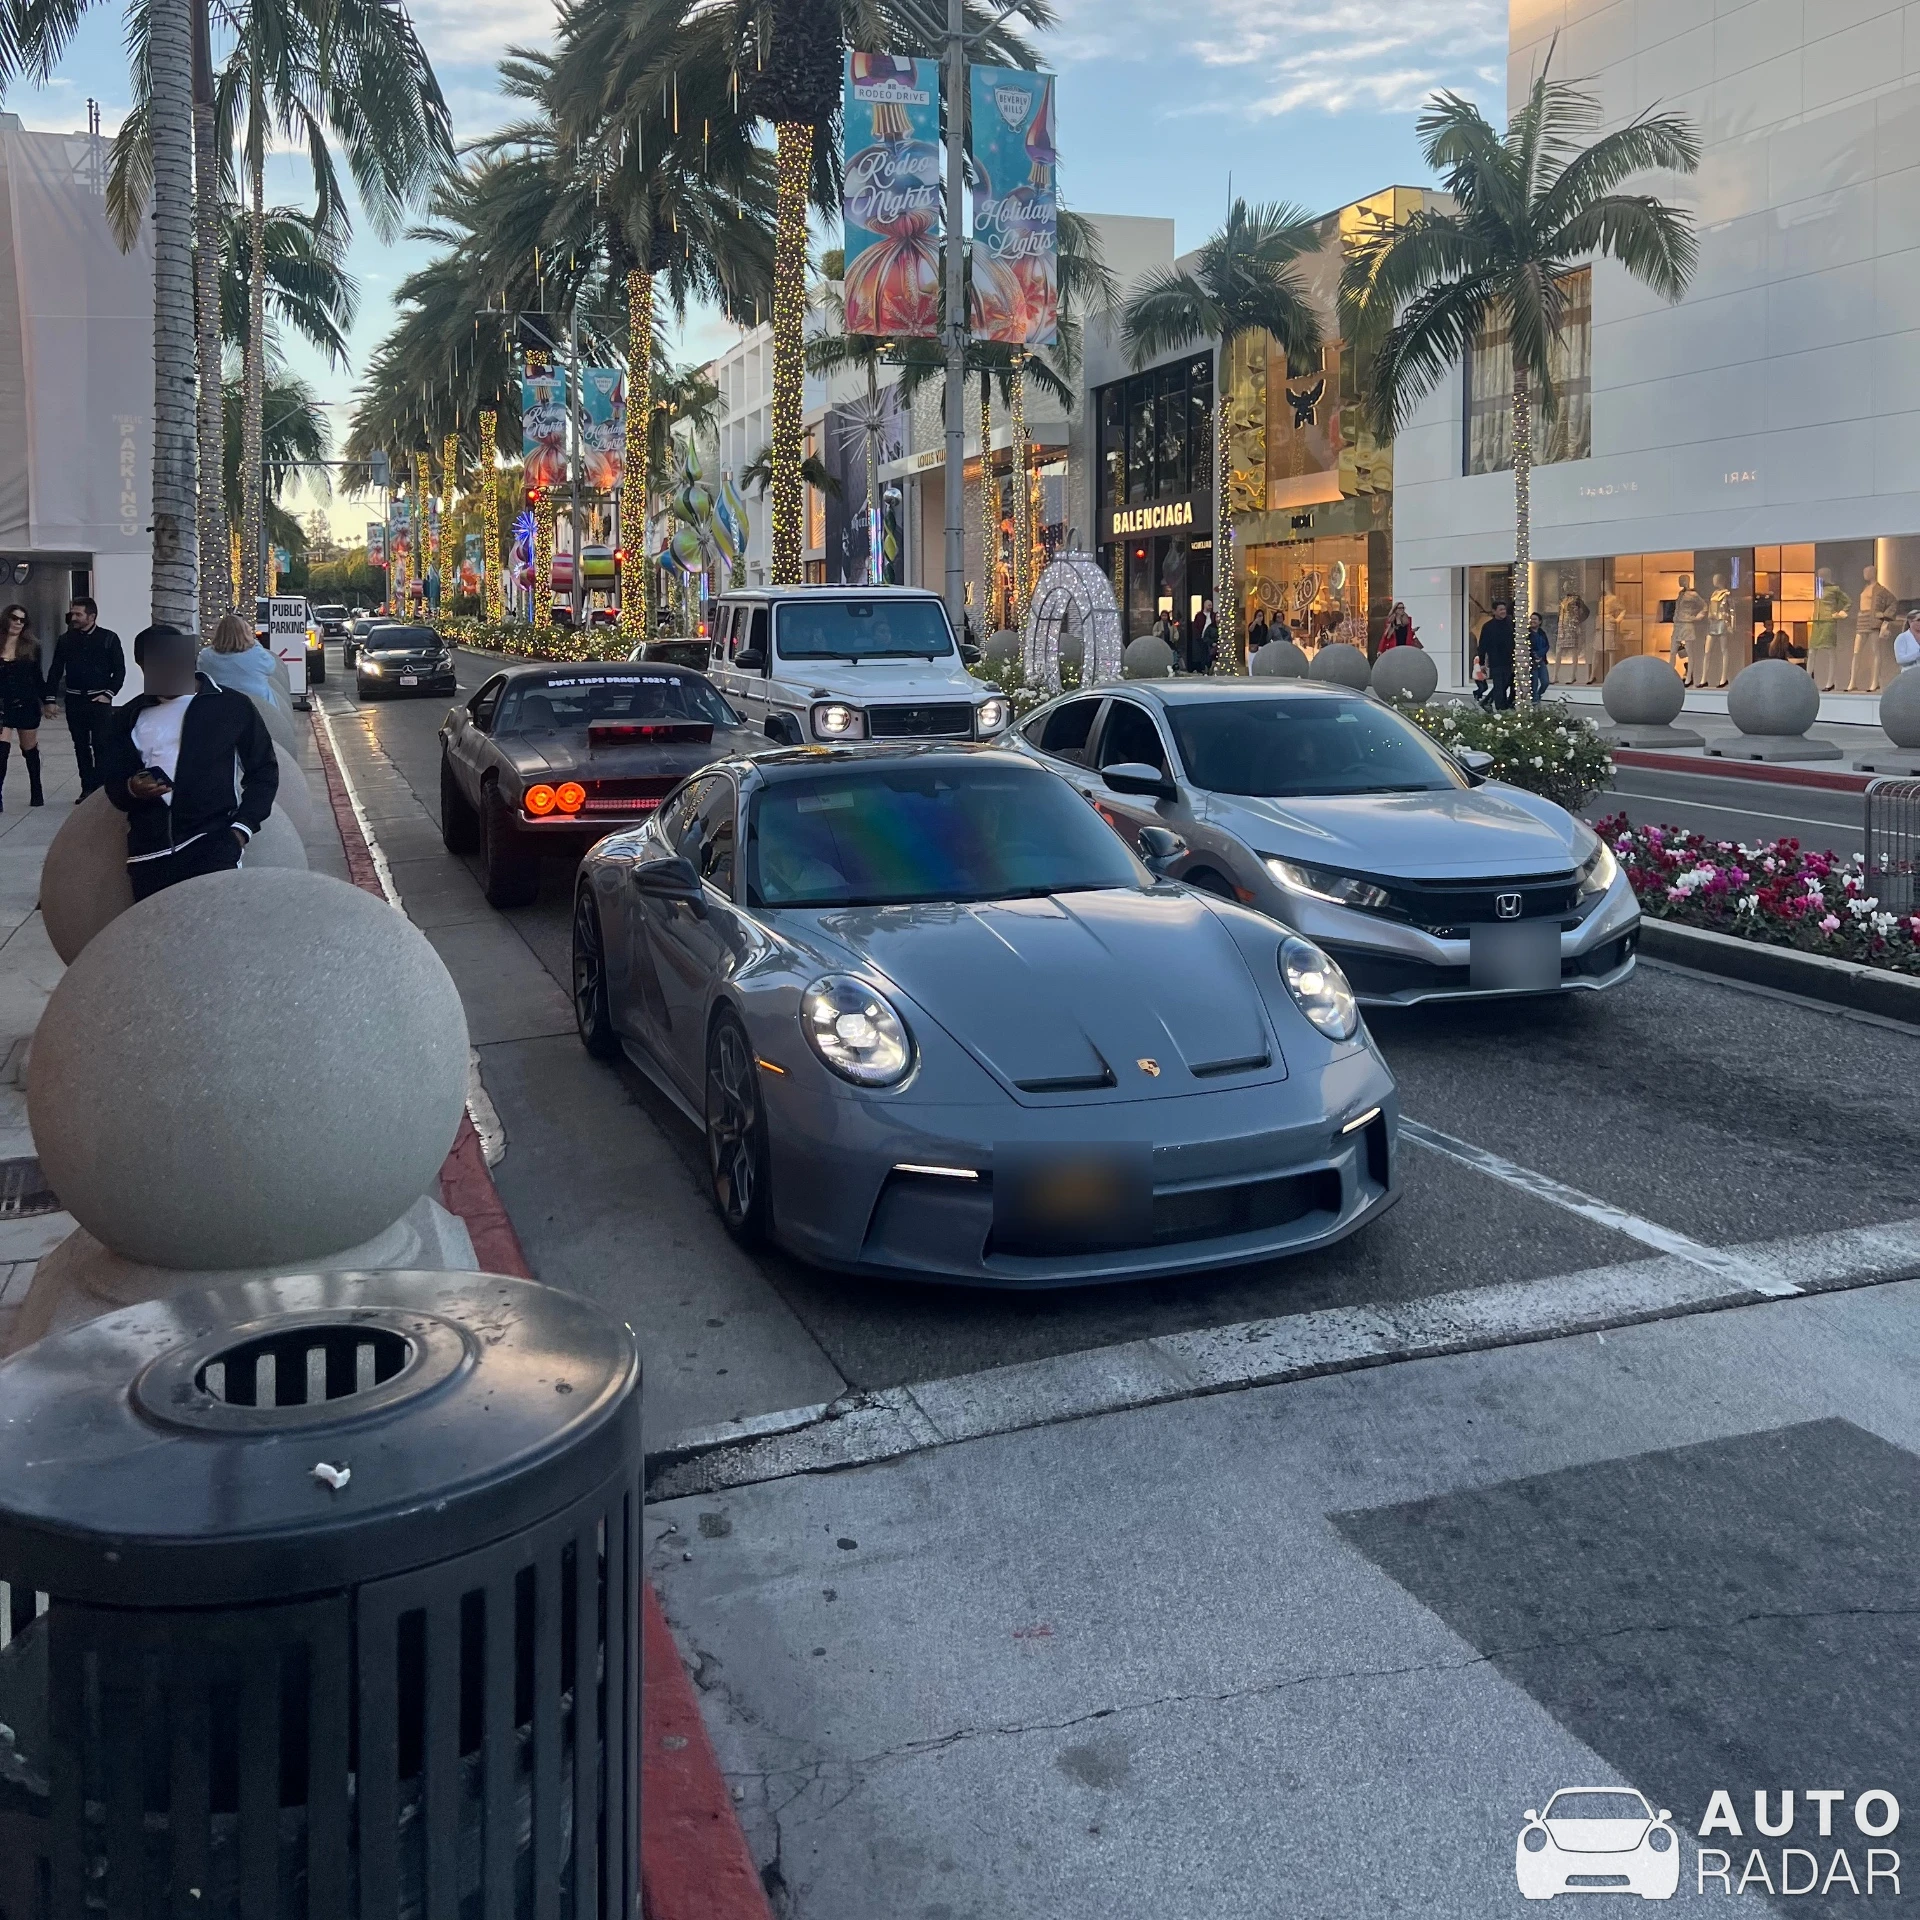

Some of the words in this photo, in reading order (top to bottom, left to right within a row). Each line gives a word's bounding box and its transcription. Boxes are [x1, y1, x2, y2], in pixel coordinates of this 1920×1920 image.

[859, 88, 892, 99] RODEO
[896, 90, 925, 102] DRIVE
[999, 94, 1028, 105] BEVERLY
[1003, 104, 1023, 115] HILLS
[857, 151, 930, 189] Rodeo
[851, 185, 936, 224] Nights
[974, 197, 1055, 233] Holiday
[988, 230, 1056, 260] Lights
[526, 422, 565, 438] Nights
[591, 437, 626, 452] Lights
[917, 451, 934, 468] LOUIS
[120, 424, 138, 518] PARKING
[1113, 501, 1193, 534] BALENCIAGA
[272, 603, 303, 617] PUBLIC
[270, 621, 305, 634] PARKING
[548, 679, 576, 687] DUCT
[578, 677, 605, 685] TAPE
